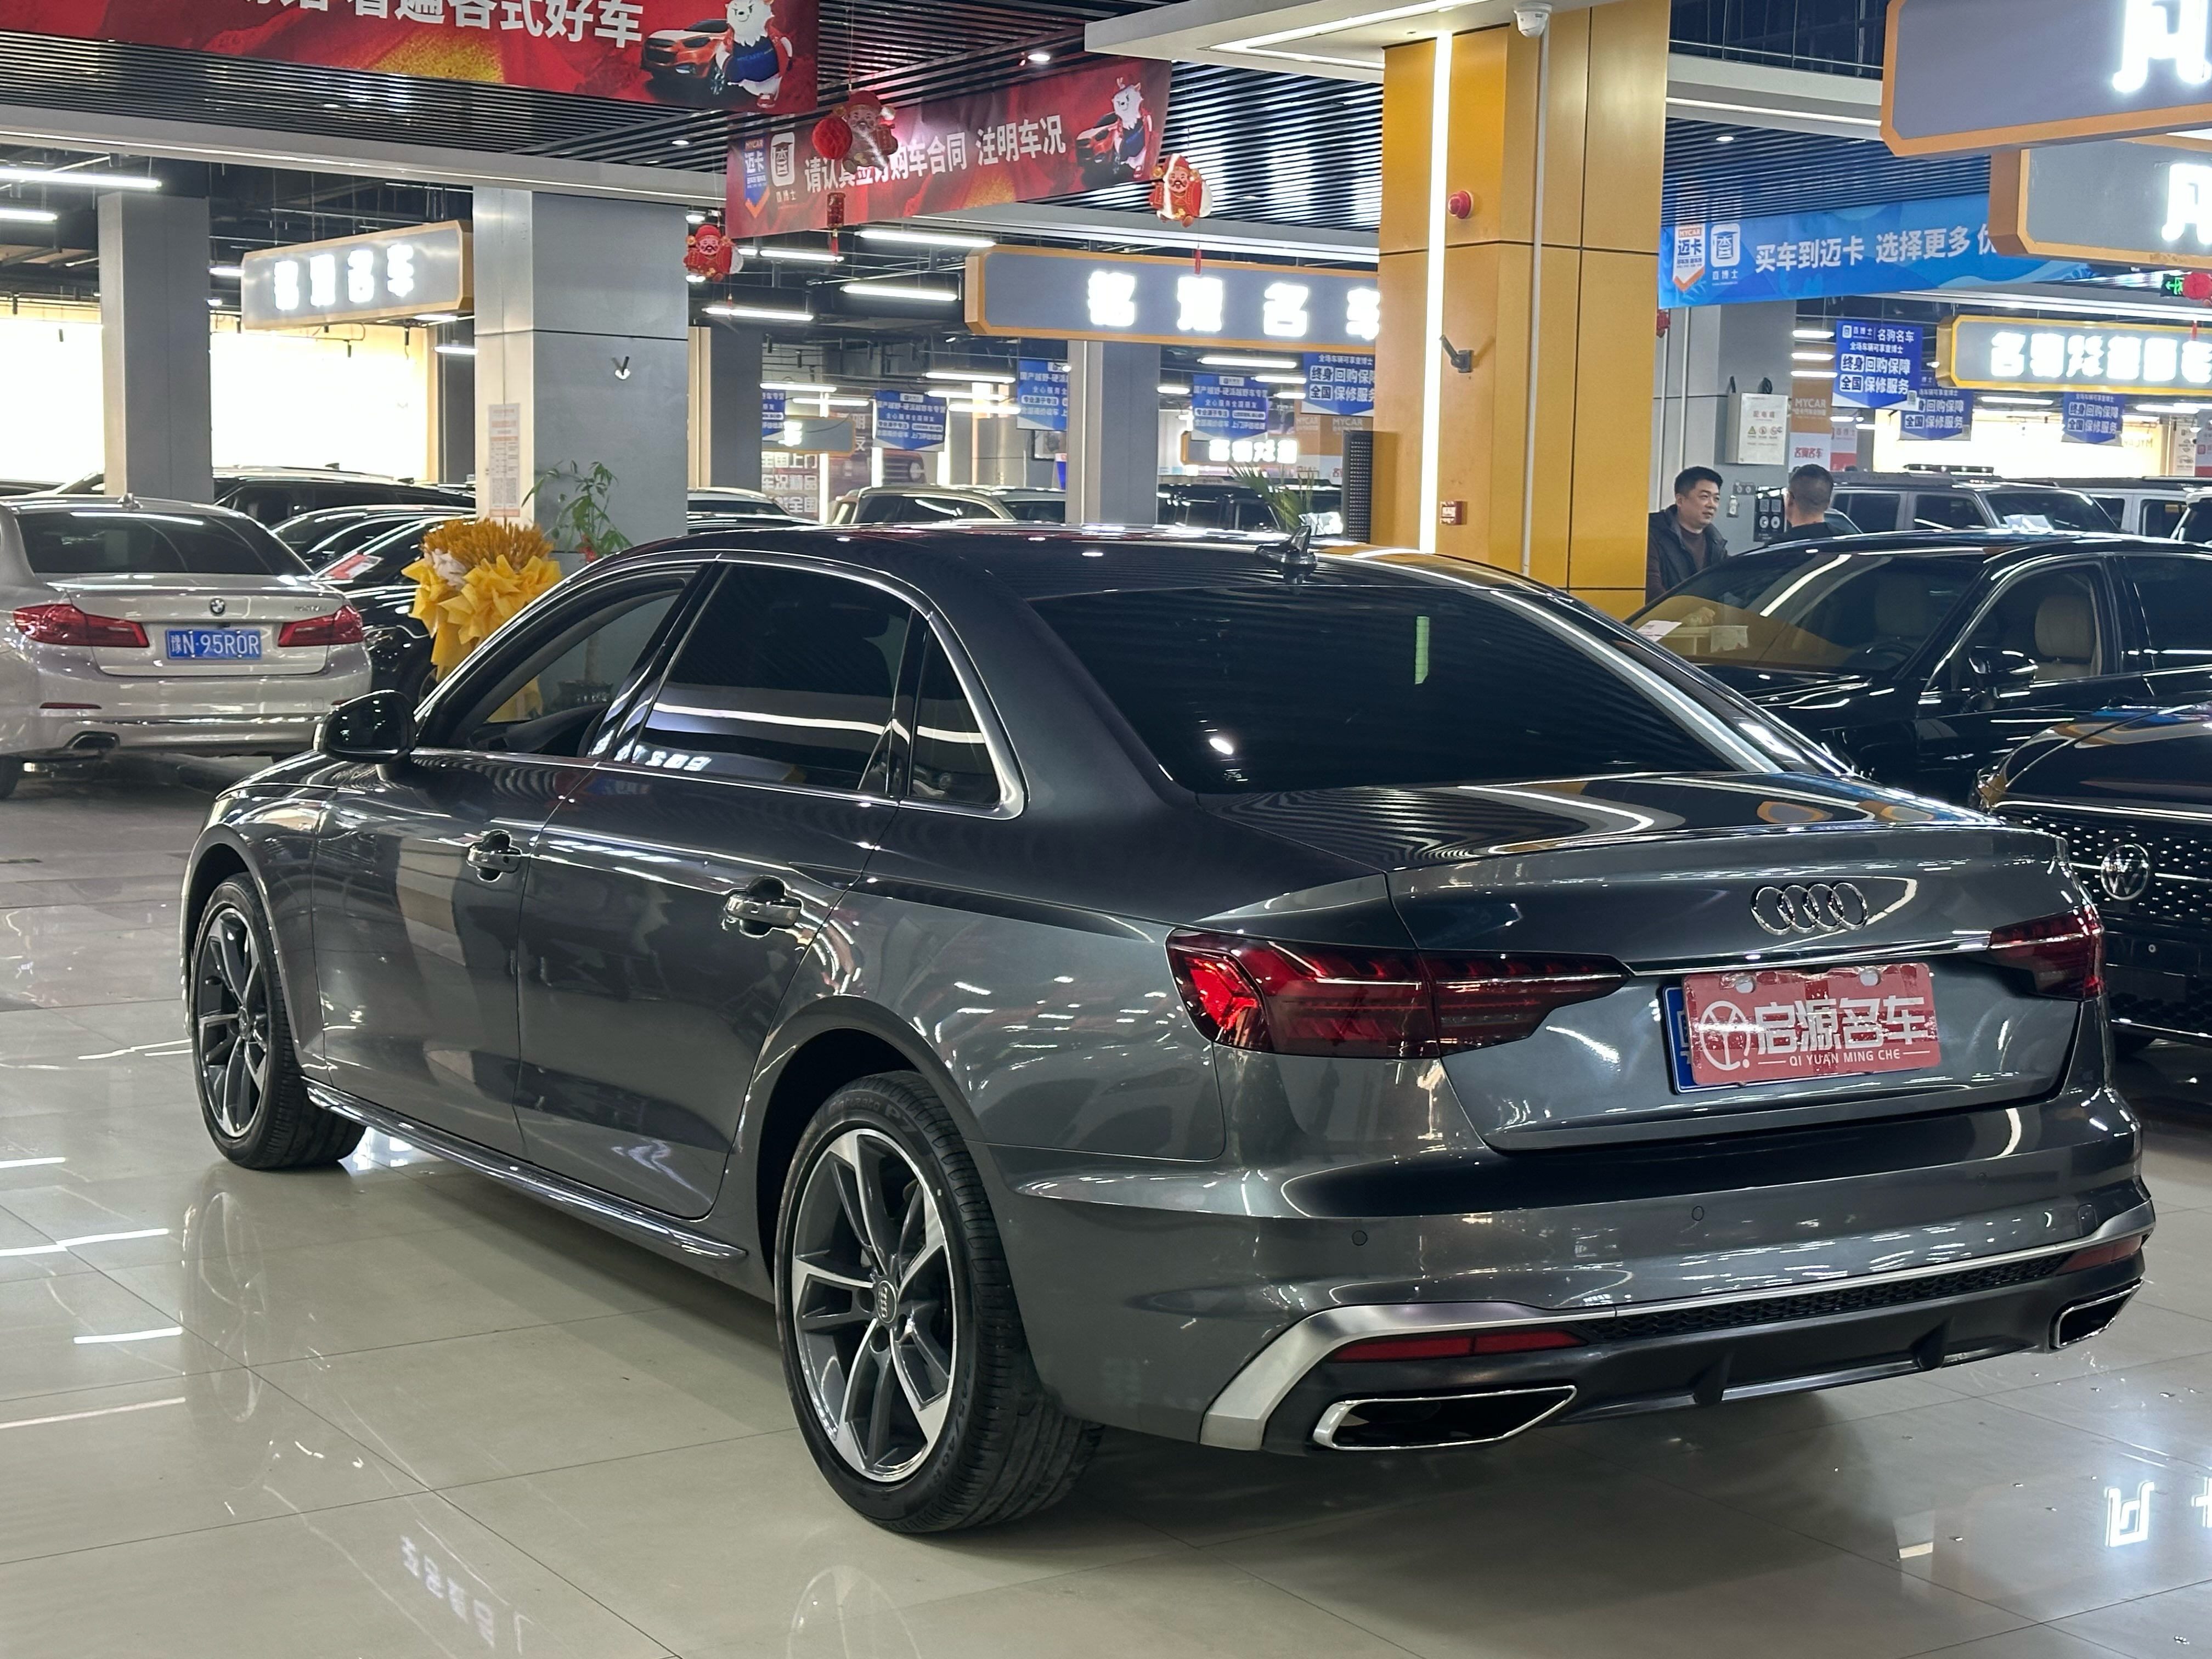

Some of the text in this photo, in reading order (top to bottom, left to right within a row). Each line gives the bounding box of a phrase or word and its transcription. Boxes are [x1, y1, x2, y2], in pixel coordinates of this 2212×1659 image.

[975, 115, 1066, 166] 注明车况
[744, 150, 764, 173] 迈卡
[1678, 238, 1702, 256] 迈卡
[1755, 235, 1864, 273] 买车到迈卡
[1876, 226, 1971, 264] 选择更多
[1795, 398, 1826, 408] MYCAR
[1754, 995, 1929, 1055] 启源名车
[1790, 1048, 1900, 1067] QI YUAN MING CHE
